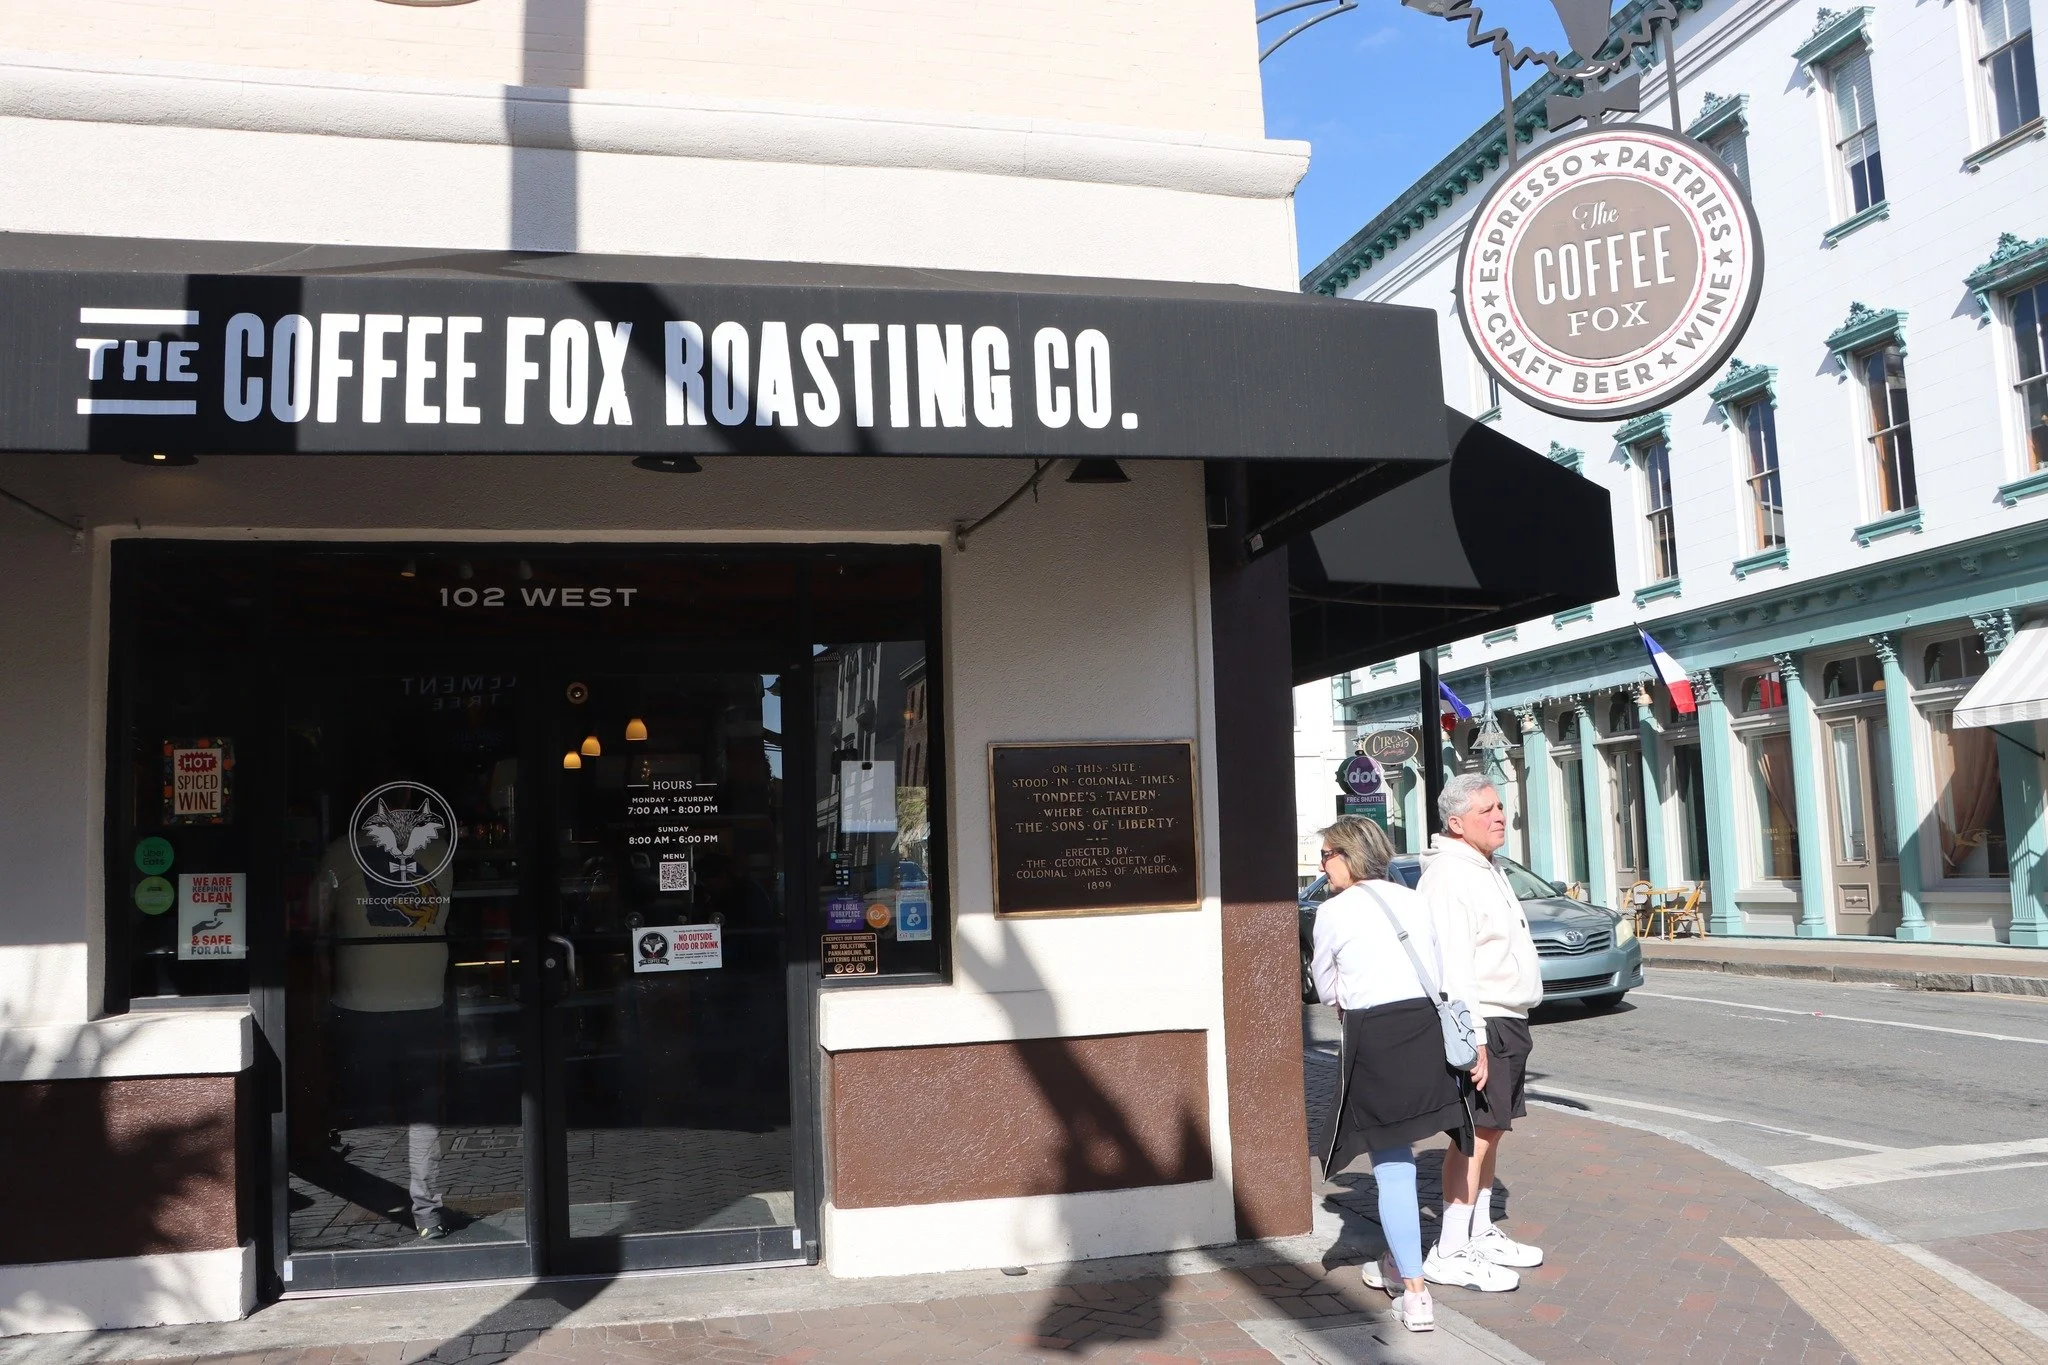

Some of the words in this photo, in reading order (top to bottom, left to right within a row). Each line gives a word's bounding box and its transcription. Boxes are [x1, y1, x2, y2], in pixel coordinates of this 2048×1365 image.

[1616, 146, 1732, 243] PASTRIES
[1480, 155, 1583, 283] ESPRESSO
[1572, 200, 1620, 231] The
[1533, 225, 1676, 306] COFFEE
[1675, 272, 1733, 351] WINE
[1567, 300, 1650, 337] FOX
[1487, 312, 1563, 386] CRAFT
[1572, 362, 1654, 394] BEER
[76, 338, 199, 382] THE
[223, 312, 483, 425] COFFEE
[504, 316, 634, 426] FOX
[664, 321, 1013, 428] ROASTING
[1033, 327, 1138, 430] CO.
[439, 587, 506, 607] 102
[520, 587, 638, 607] WEST
[184, 757, 213, 768] HOT
[1052, 765, 1067, 774] ON
[1075, 764, 1102, 773] THIS
[1111, 763, 1136, 772] SITE
[1012, 778, 1048, 788] STOOD
[1057, 778, 1069, 787] IN
[1078, 776, 1133, 786] COLONIAL
[1140, 775, 1175, 784] TIMES
[1348, 768, 1379, 783] dot
[177, 774, 219, 790] SPICED
[652, 780, 693, 790] HOURS
[178, 791, 219, 811] WINE
[1033, 791, 1097, 803] TONDEE'S
[1106, 789, 1157, 801] TAVERN
[1361, 795, 1385, 803] SHUTTLE
[628, 806, 650, 815] 7:00
[653, 806, 669, 814] AM
[678, 805, 701, 813] 8:00
[704, 805, 718, 813] PM
[1043, 808, 1083, 817] WHERE
[1092, 806, 1148, 816] GATHERED
[1015, 822, 1043, 833] THE
[1051, 820, 1085, 832] SONS
[1092, 819, 1109, 831] OF
[1117, 817, 1175, 830] LIBERTY
[629, 836, 651, 845] 8:00
[654, 836, 670, 844] AM
[678, 835, 701, 844] 6:00
[704, 835, 718, 843] PM
[1065, 847, 1110, 857] ERECTED
[1116, 846, 1129, 855] BY
[1026, 859, 1046, 869] THE
[1054, 858, 1098, 867] GEORGIA
[1105, 856, 1148, 866] SOCIETY
[1153, 855, 1166, 864] OF
[1016, 870, 1067, 879] COLONIAL
[1074, 867, 1108, 876] DAMES
[1114, 866, 1127, 876] OF
[1132, 865, 1178, 875] AMERICA
[193, 877, 209, 886] WE
[211, 876, 232, 886] ARE
[1087, 881, 1112, 890] 1899
[192, 892, 232, 904] CLEAN
[356, 896, 451, 905] THECOFFEEFOX.COM
[832, 903, 842, 911] TOP
[843, 903, 858, 911] LOCAL
[191, 935, 200, 946] &
[202, 935, 232, 945] SAFE
[679, 934, 688, 942] NO
[688, 932, 713, 941] OUTSIDE
[191, 946, 211, 955] FOR
[213, 945, 232, 955] ALL
[673, 942, 690, 951] FOOD
[690, 942, 699, 950] OR
[700, 941, 719, 950] DRINK
